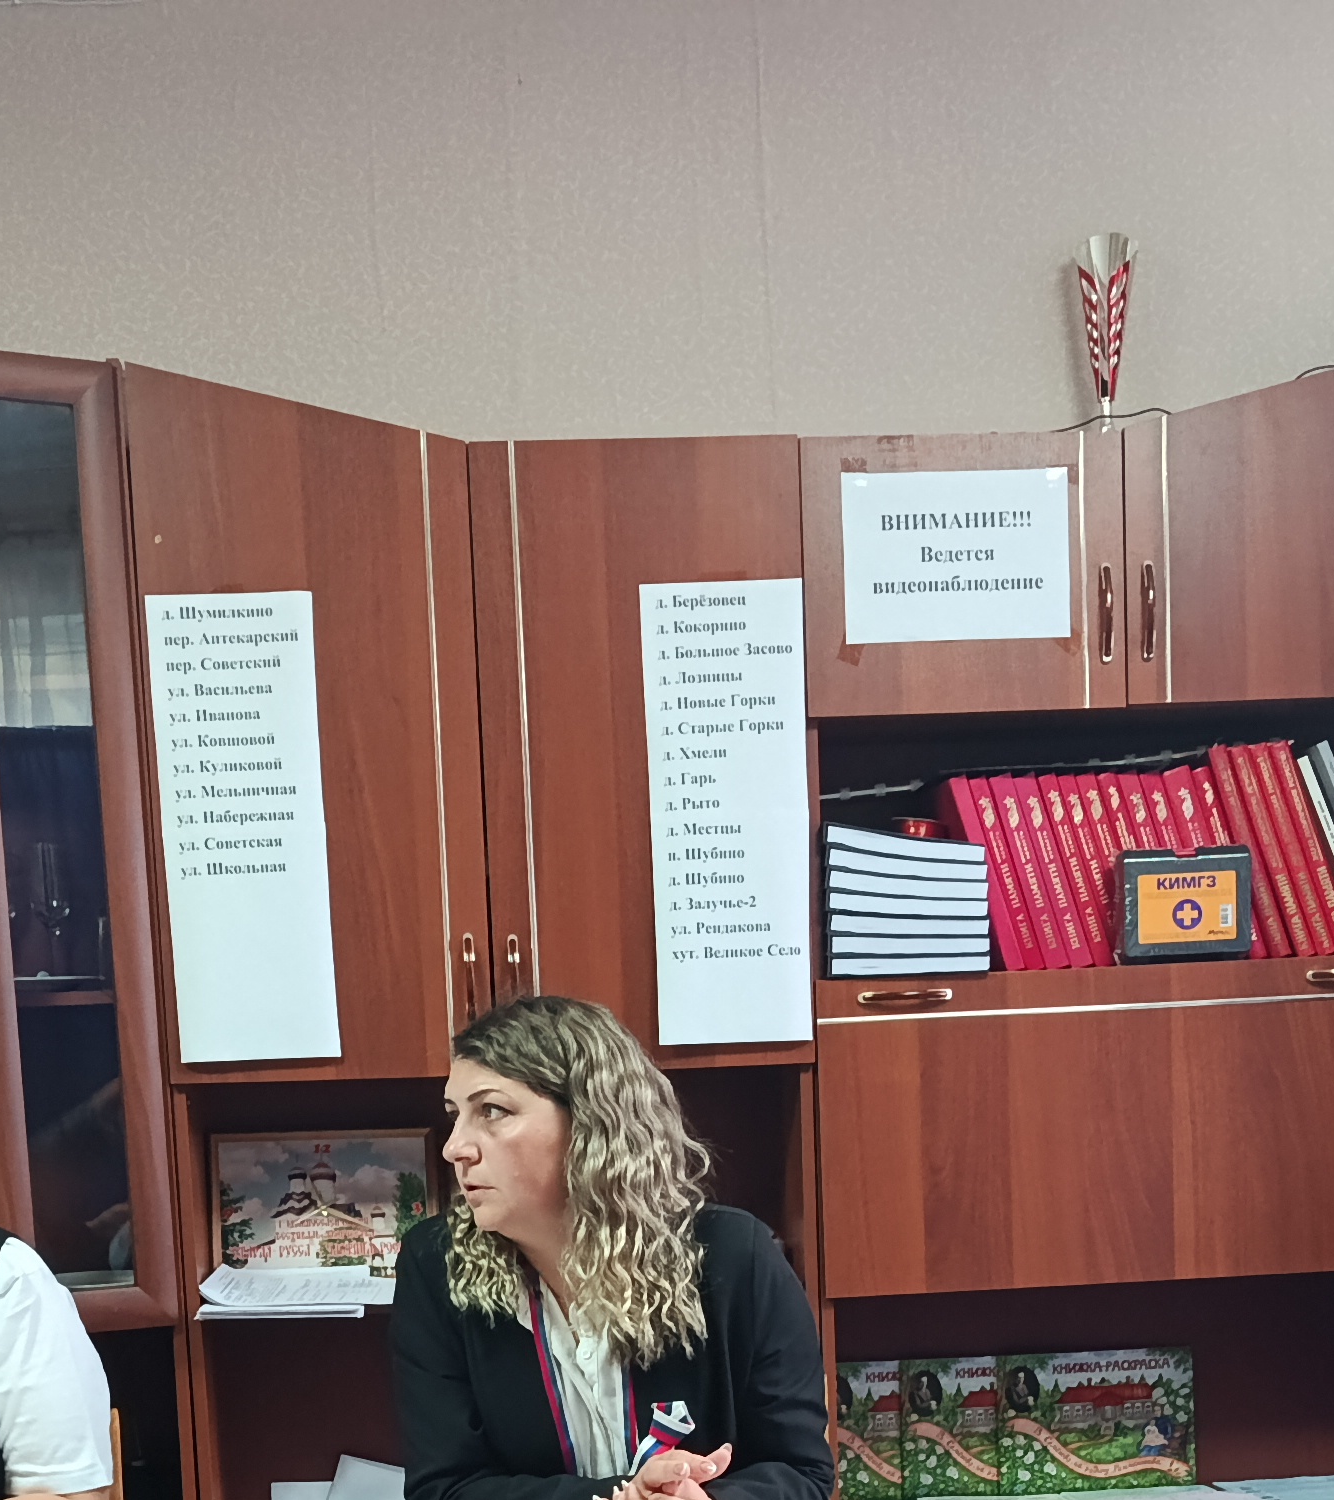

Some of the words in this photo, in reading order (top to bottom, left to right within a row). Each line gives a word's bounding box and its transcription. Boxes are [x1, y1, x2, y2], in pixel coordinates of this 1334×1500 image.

[882, 511, 1031, 531] ВНИМАНИЕ!!!
[921, 547, 994, 563] Ведется
[873, 575, 1043, 594] видеонаблюдение
[656, 599, 667, 609] д.
[673, 595, 746, 611] Берёзовец
[162, 611, 174, 620] д.
[180, 607, 273, 622] Шумилкино
[657, 625, 668, 635] д.
[674, 621, 746, 635] Кокорино
[165, 636, 194, 649] пер.
[199, 629, 298, 646] Аптекарский
[658, 651, 670, 660] д.
[675, 646, 739, 659] Большое
[744, 643, 792, 655] Засово
[166, 662, 196, 675] пер.
[201, 655, 280, 670] Советский
[659, 676, 671, 686] д.
[675, 672, 742, 684] Лозницы
[168, 688, 189, 700] ул.
[194, 684, 272, 696] Васильева
[660, 701, 672, 711] д.
[678, 697, 725, 709] Новые
[731, 694, 775, 709] Горки
[169, 714, 190, 726] ул.
[196, 709, 260, 721] Иванова
[662, 727, 673, 736] д.
[678, 722, 734, 737] Старые
[740, 719, 783, 734] Горки
[172, 739, 192, 752] ул.
[198, 733, 274, 747] Ковшовой
[663, 752, 674, 761] д.
[680, 747, 726, 759] Хмели
[173, 765, 194, 777] ул.
[200, 758, 282, 776] Куликовой
[664, 777, 676, 786] д.
[681, 773, 716, 787] Гарь
[175, 790, 196, 803] ул.
[201, 786, 296, 798] Мельничная
[665, 802, 677, 812] д.
[683, 798, 719, 810] Рыто
[177, 815, 198, 828] ул.
[204, 810, 294, 825] Набережная
[666, 828, 678, 837] д.
[684, 823, 741, 835] Местцы
[179, 842, 199, 855] ул.
[204, 838, 282, 850] Советская
[668, 853, 680, 861] п.
[686, 847, 744, 863] Шубино
[181, 867, 201, 880] ул.
[207, 863, 286, 875] Школьная
[669, 877, 680, 887] д.
[686, 872, 744, 888] Шубино
[1156, 875, 1217, 890] КИМГЗ
[670, 902, 681, 911] д.
[686, 896, 756, 912] Залучье-2
[671, 926, 691, 938] ул.
[697, 922, 770, 934] Рендакова
[672, 951, 699, 963] хут.
[704, 947, 763, 958] Великое
[768, 944, 800, 956] Село
[1052, 1357, 1171, 1375] КНИЖКА-РАСКРАСКА
